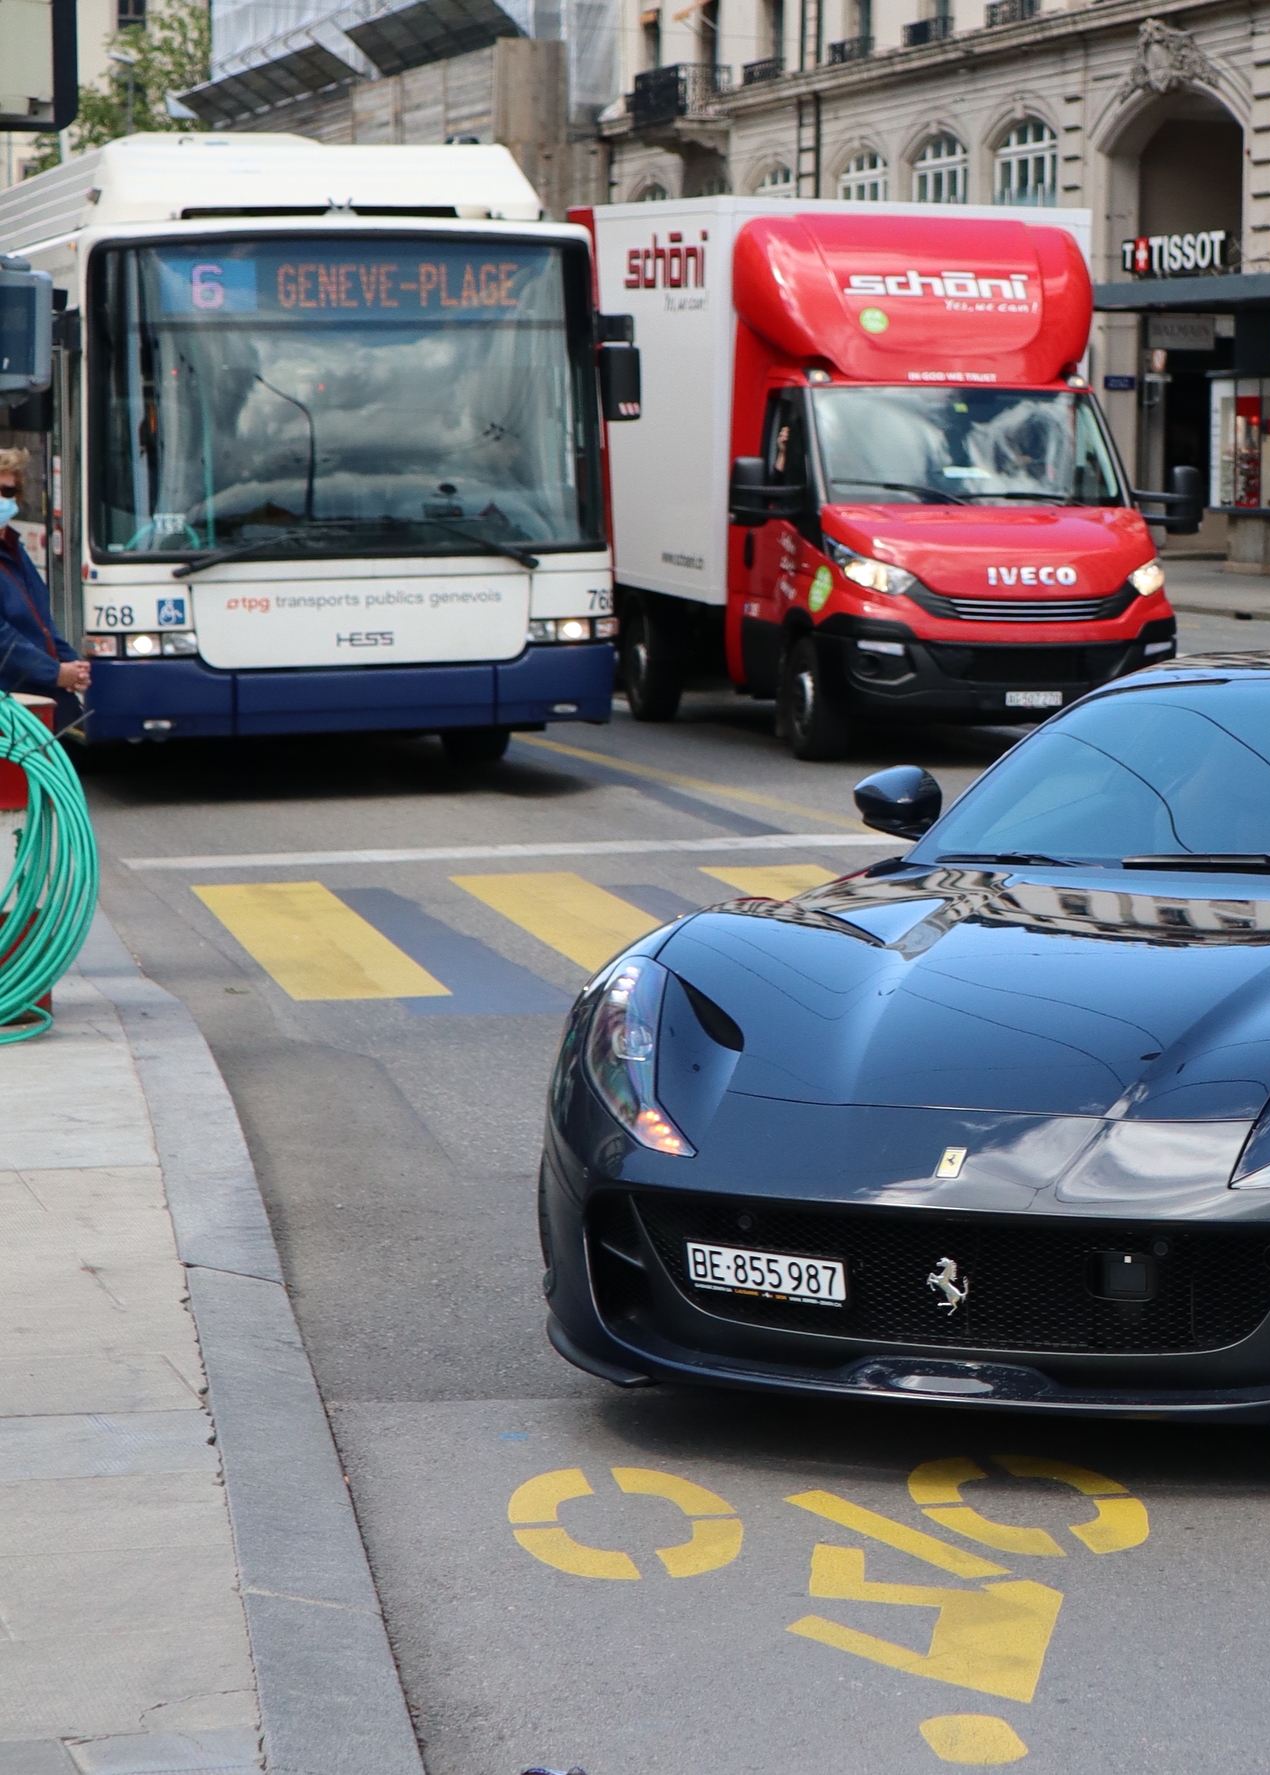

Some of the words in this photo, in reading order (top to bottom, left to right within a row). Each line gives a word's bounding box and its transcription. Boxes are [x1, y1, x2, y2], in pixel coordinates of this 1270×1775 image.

[1148, 230, 1226, 271] TISSOT
[191, 264, 225, 309] 6
[276, 262, 518, 308] GENEVE-PLAGE
[987, 566, 1078, 586] IVECO
[275, 592, 359, 611] transports
[365, 590, 424, 609] publics
[429, 589, 502, 608] genevois
[94, 605, 134, 627] 768
[336, 631, 395, 648] HESS
